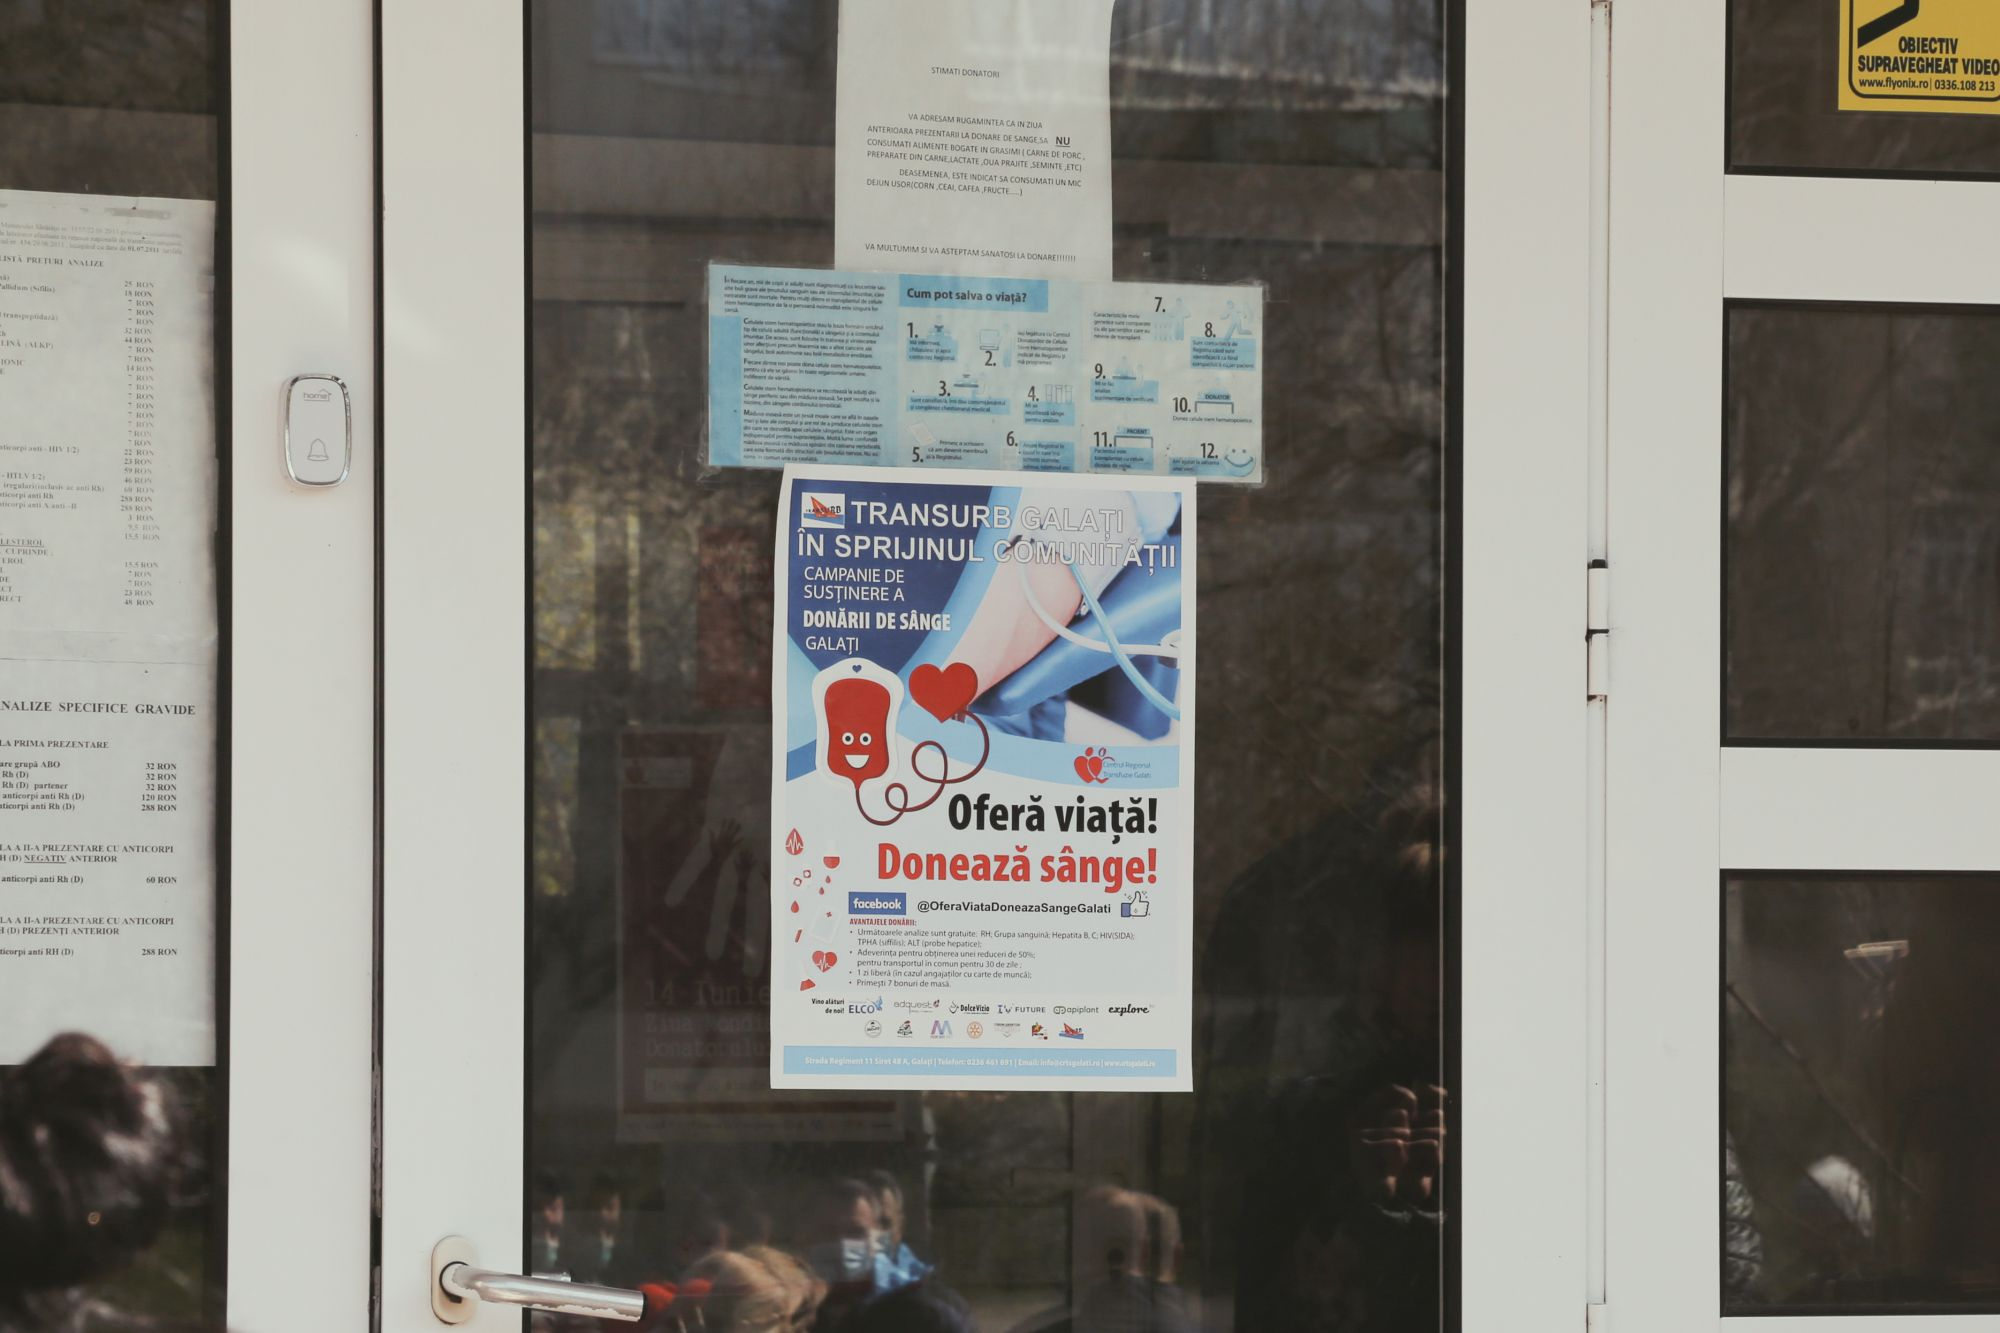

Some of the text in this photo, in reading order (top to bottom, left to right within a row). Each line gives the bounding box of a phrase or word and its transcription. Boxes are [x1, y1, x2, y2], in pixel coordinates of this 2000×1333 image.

[1898, 36, 1958, 54] OBIECTIV
[931, 67, 1000, 78] STIMATI DONATORI
[1858, 55, 2000, 76] SUPRAVEGHEAT VIDEO
[1859, 77, 1995, 91] www.flyonix.ro 0336.108 213
[920, 114, 955, 123] ADRESAM
[957, 117, 1004, 127] RUGAMINTEA
[1017, 120, 1025, 128] IN
[1026, 121, 1043, 129] ZIUA
[867, 126, 913, 135] ANTERIOARA
[915, 129, 960, 138] PREZENTARII
[971, 133, 1001, 141] DONARE
[1055, 136, 1070, 146] NU
[867, 139, 911, 148] CONSUMATI
[913, 141, 948, 151] ALIMENTE
[950, 144, 978, 153] BOGATE
[989, 147, 1020, 156] GRASIMI
[1026, 149, 1049, 158] CARNE
[1051, 150, 1060, 158] DE
[867, 151, 907, 160] PREPARATE
[909, 153, 923, 161] DIN
[1001, 160, 1028, 168] PRAJITE
[866, 179, 890, 187] DEJUN
[958, 184, 980, 193] CAFEA
[899, 169, 951, 179] DEASEMENEA,
[952, 172, 968, 180] ESTE
[970, 173, 997, 182] INDICAT
[999, 175, 1008, 183] SA
[1010, 176, 1054, 185] CONSUMATI
[1067, 179, 1082, 187] MIC
[877, 244, 920, 253] MULTUMIM
[929, 246, 939, 254] VA
[941, 247, 980, 256] ASTEPTAM
[980, 249, 1015, 259] SANATOSI
[1017, 251, 1026, 259] LA
[907, 288, 931, 299] Cum
[934, 290, 953, 301] pot
[955, 290, 983, 301] salva
[986, 293, 992, 301] o
[1154, 296, 1166, 312] 7.
[907, 322, 919, 338] 1.
[1204, 322, 1216, 338] 8.
[985, 351, 997, 367] 2.
[1094, 363, 1106, 379] 9.
[939, 380, 951, 397] 3.
[1027, 386, 1039, 402] 4.
[1172, 397, 1191, 413] 10.
[1006, 431, 1018, 447] 6.
[1093, 432, 1113, 447] 11.
[912, 447, 924, 463] 5.
[1200, 443, 1219, 459] 12.
[851, 500, 1123, 542] TRANSURB GALAȚI
[798, 528, 824, 557] ÎN
[834, 534, 984, 562] SPRIJINUL
[804, 566, 904, 584] CAMPANIE DE
[804, 584, 904, 603] SUSȚINERE A
[803, 607, 951, 631] DONĂRII DE SÂNGE
[805, 636, 860, 656] GALAȚI
[0, 701, 196, 715] NALIZE SPECIFICE GRAVIDE
[14, 740, 109, 749] PRIMA PREZENTARE
[14, 761, 38, 769] grupă
[16, 771, 29, 779] (D)
[145, 773, 177, 781] 32 RON
[16, 782, 29, 790] (D)
[34, 783, 68, 791] partener
[2, 792, 39, 801] anticorpi
[71, 793, 85, 801] (D)
[948, 793, 1158, 845] Oferă viață!
[43, 844, 174, 853] PREZENTARE CU ANTICORPI
[24, 855, 118, 863] NEGATIV ANTERIOR
[878, 843, 1157, 894] Donează sânge!
[852, 897, 1111, 914] facebook @OferaViataDoneazaSangeGalati
[849, 918, 887, 926] AVANTAJELE
[898, 950, 923, 958] pentru
[857, 960, 881, 968] pentru
[883, 960, 924, 968] transportul
[960, 961, 984, 969] pentru
[849, 1005, 875, 1014] ELCO
[1067, 1006, 1099, 1015] apiplant
[1108, 1003, 1150, 1016] explore
